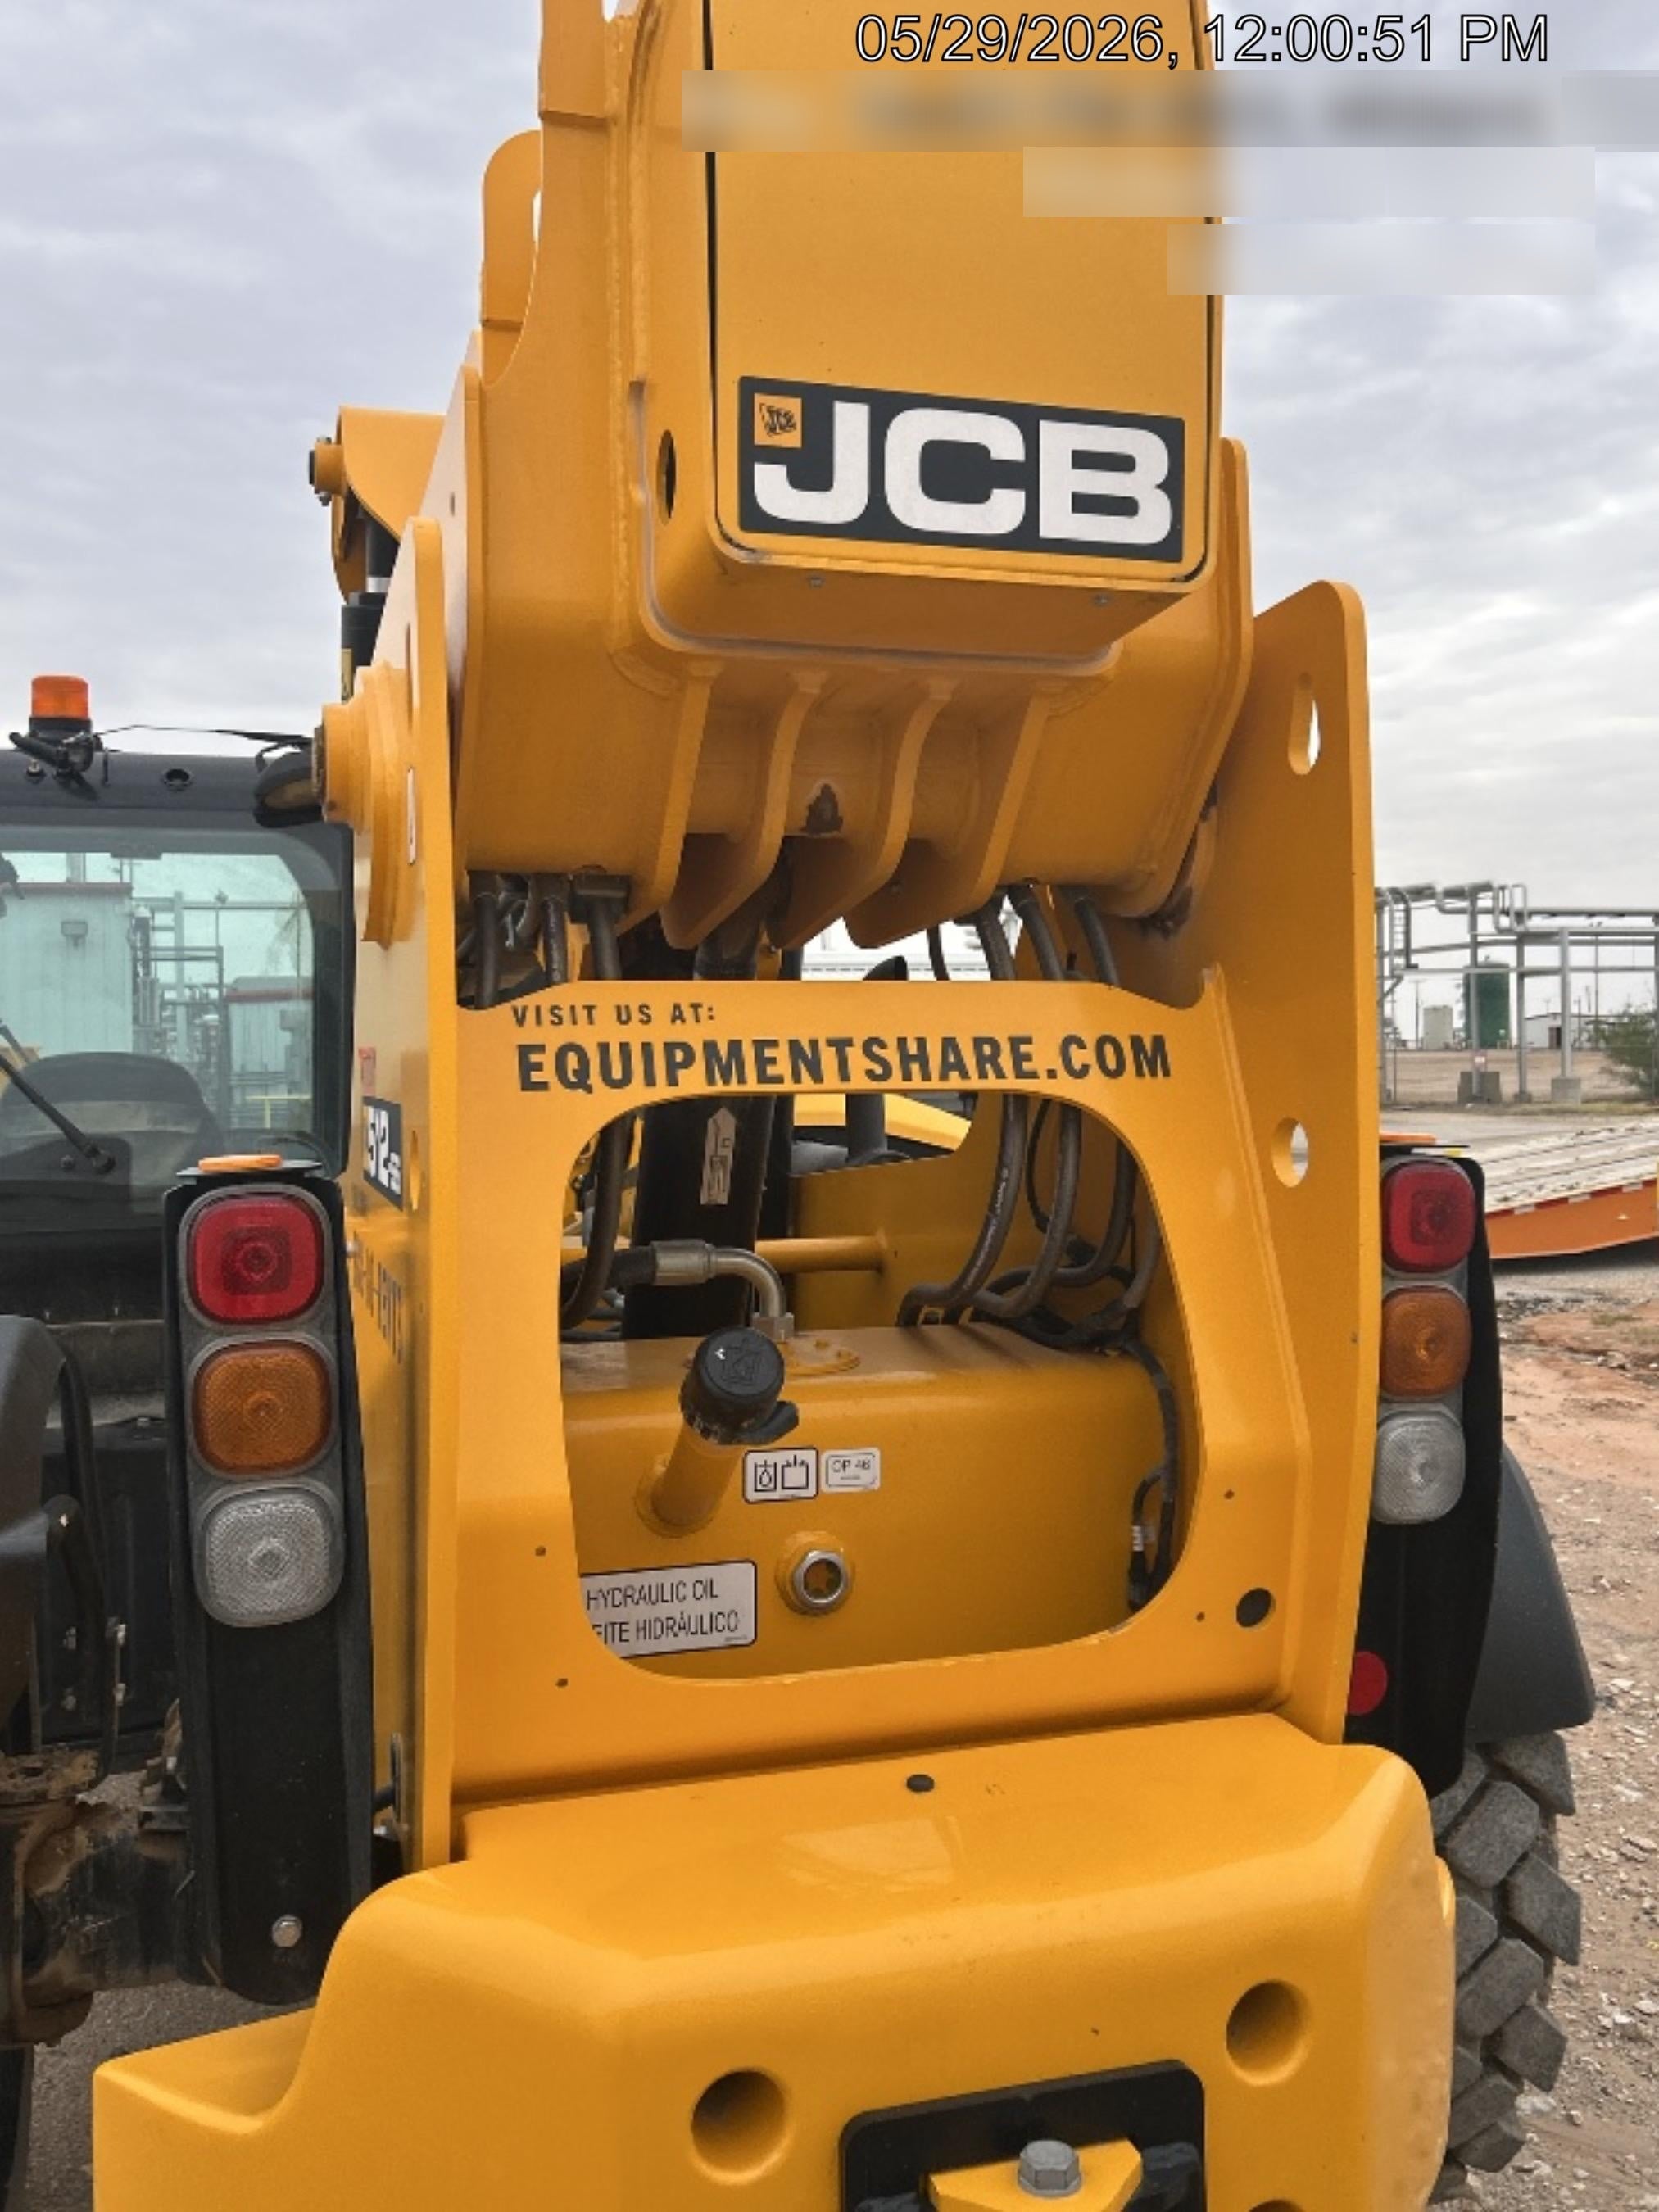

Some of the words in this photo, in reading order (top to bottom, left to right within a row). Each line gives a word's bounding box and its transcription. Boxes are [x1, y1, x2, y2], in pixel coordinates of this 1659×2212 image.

[753, 400, 1172, 546] JCB
[512, 1004, 597, 1027] VISIT
[614, 1004, 653, 1026] US
[670, 1003, 715, 1025] AT:
[517, 1033, 1172, 1094] EQUIPMENTSHARE.COM
[586, 1580, 687, 1611] HYDRAULIC
[692, 1577, 718, 1601] OIL
[635, 1609, 739, 1640] HIDRÁULICO
